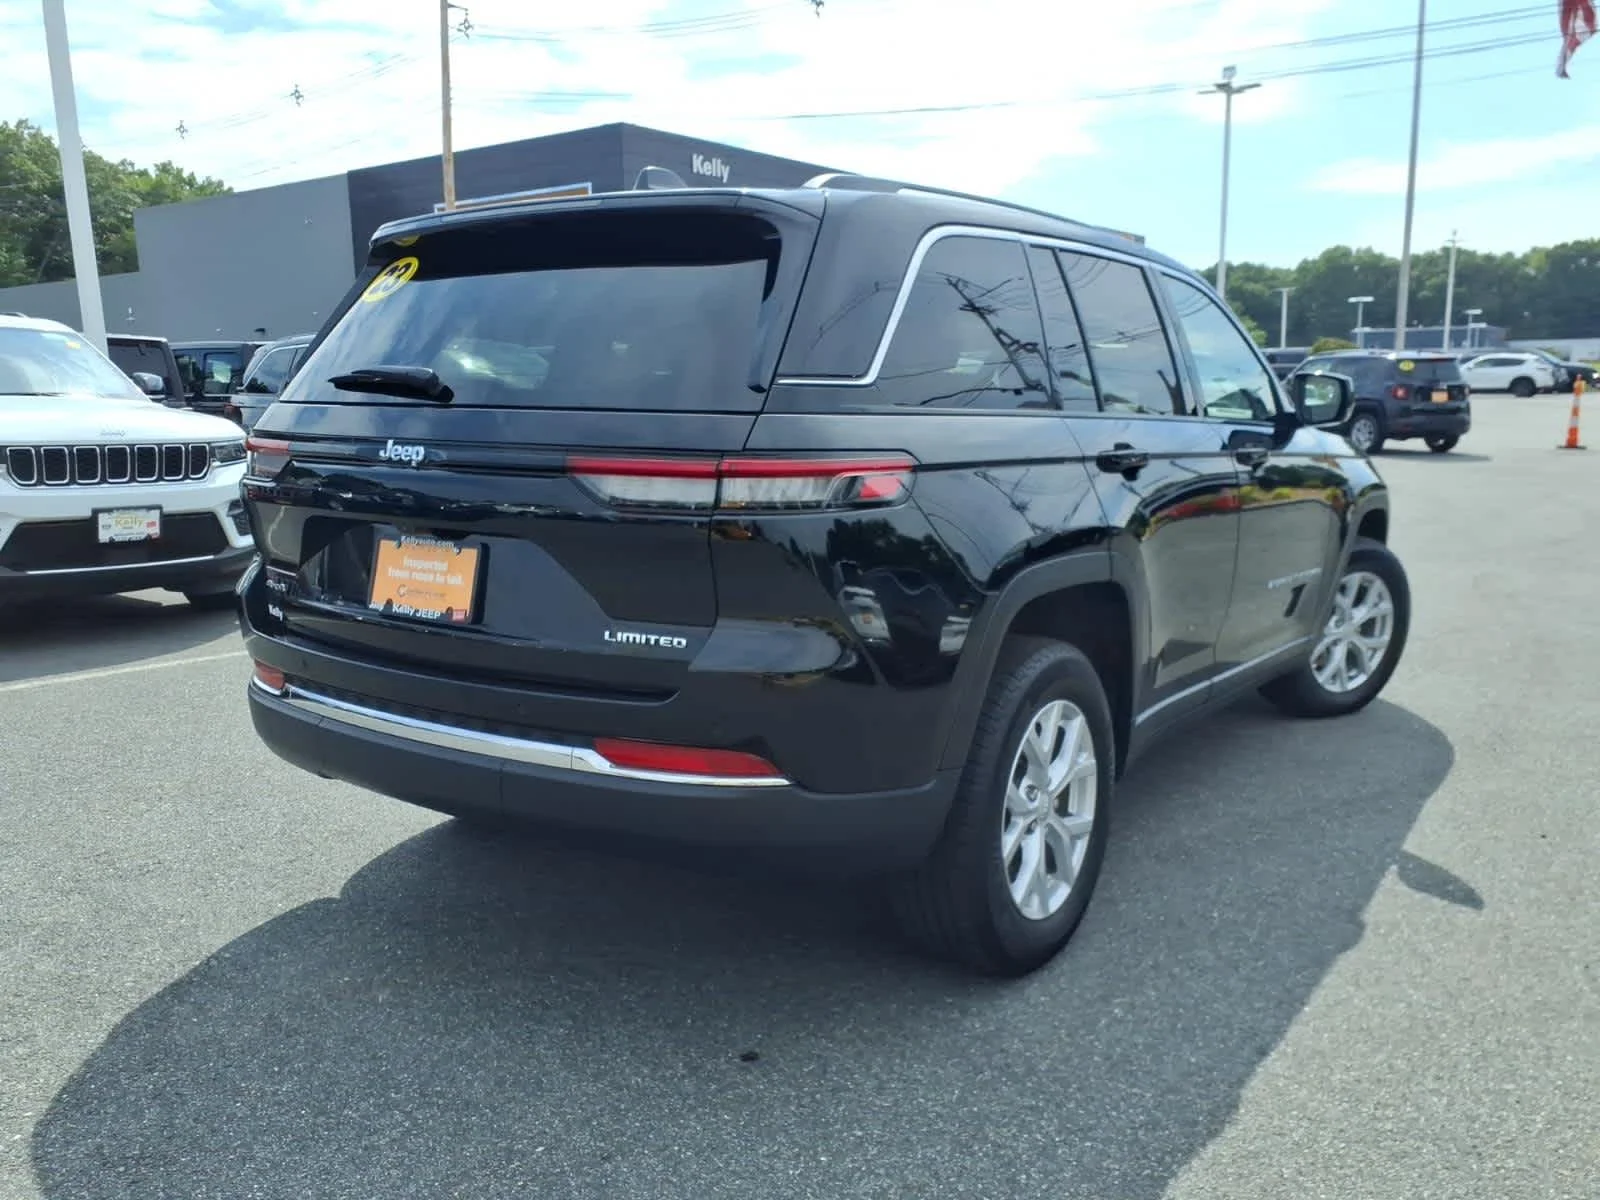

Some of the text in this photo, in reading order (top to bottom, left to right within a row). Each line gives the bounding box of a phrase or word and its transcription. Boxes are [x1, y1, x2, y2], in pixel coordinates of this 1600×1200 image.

[692, 152, 731, 184] Kelly
[378, 438, 425, 467] Jeep
[392, 603, 416, 616] Kelly
[416, 607, 441, 619] JEEP
[603, 630, 687, 648] LIMITED
